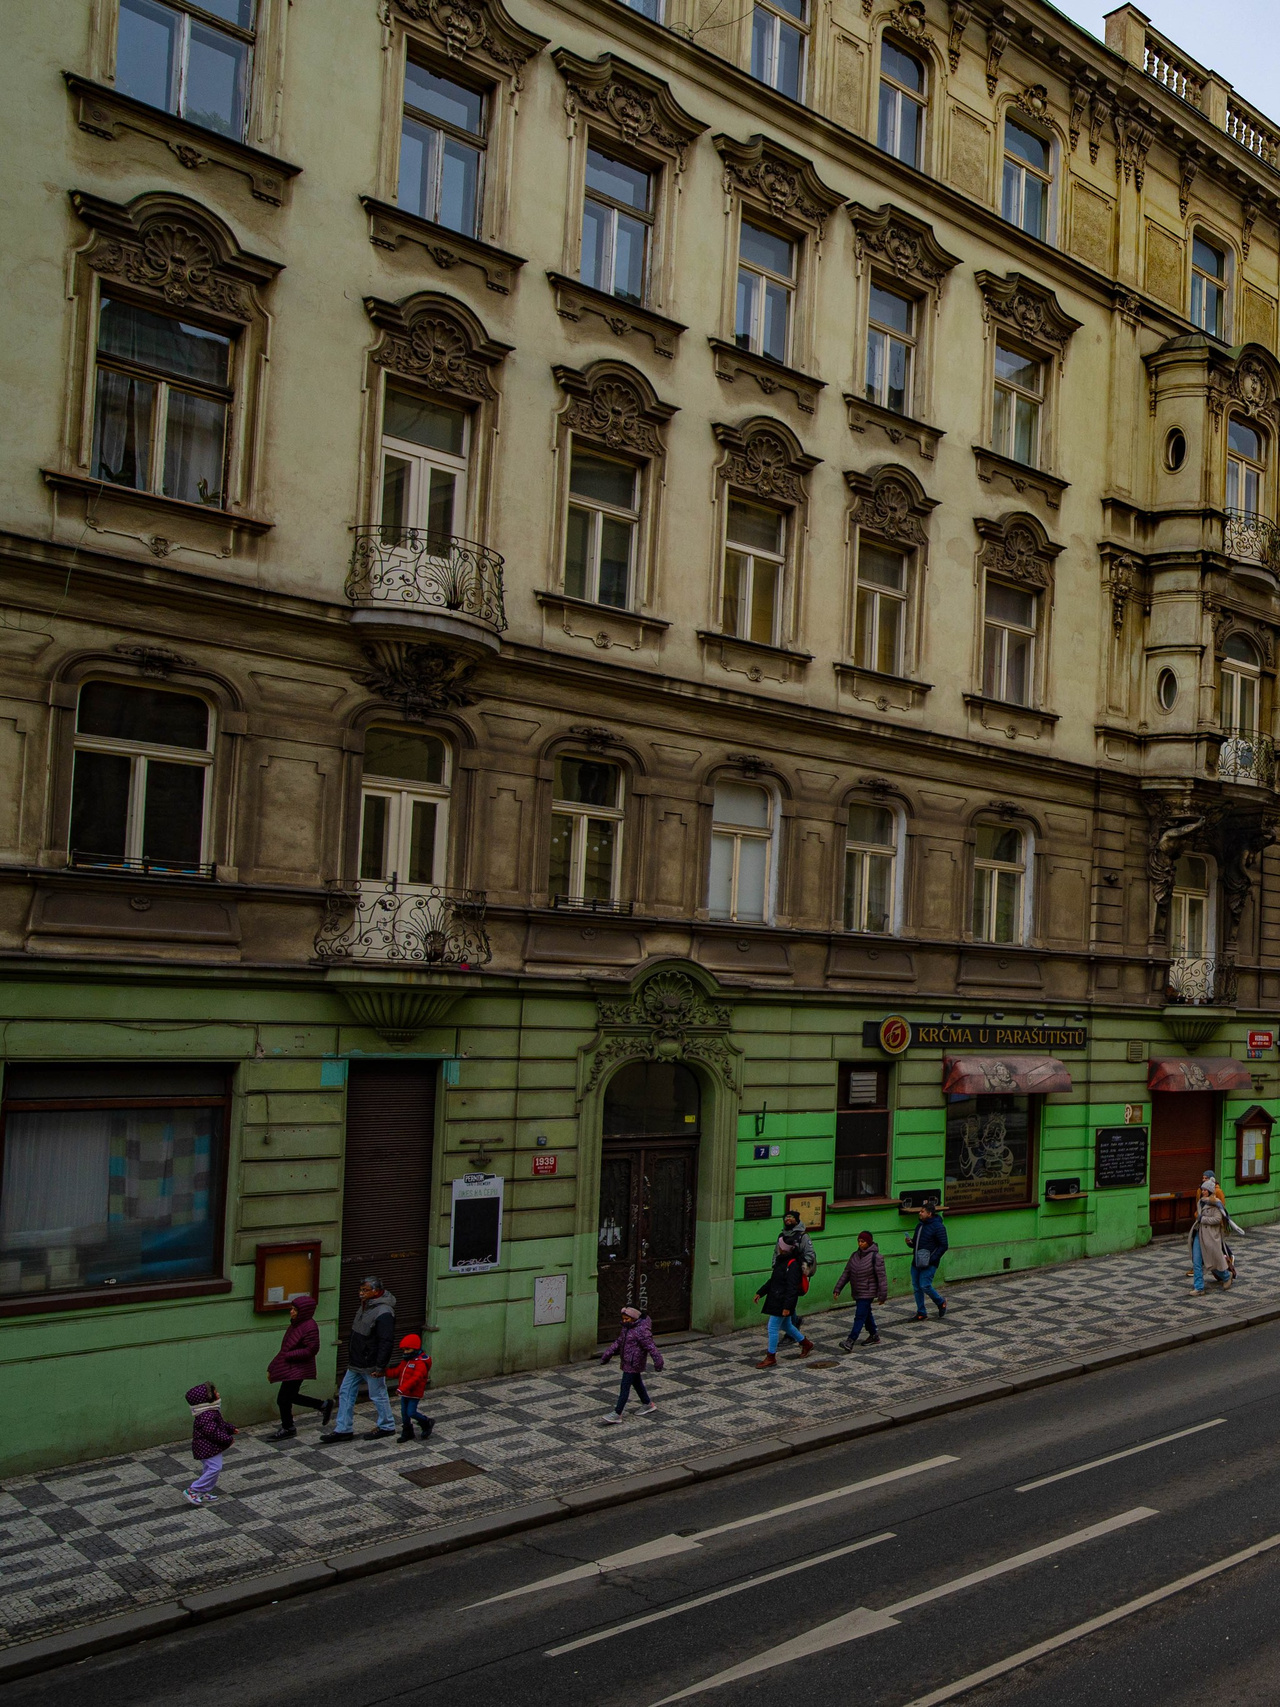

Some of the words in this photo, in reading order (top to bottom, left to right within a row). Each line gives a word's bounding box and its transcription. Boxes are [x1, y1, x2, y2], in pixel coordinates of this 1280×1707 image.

[919, 1025, 972, 1043] KRČMA
[979, 1029, 990, 1044] U
[996, 1027, 1084, 1045] PARAŠUTISTŮ
[760, 1148, 765, 1156] 7
[536, 1157, 554, 1166] 1939
